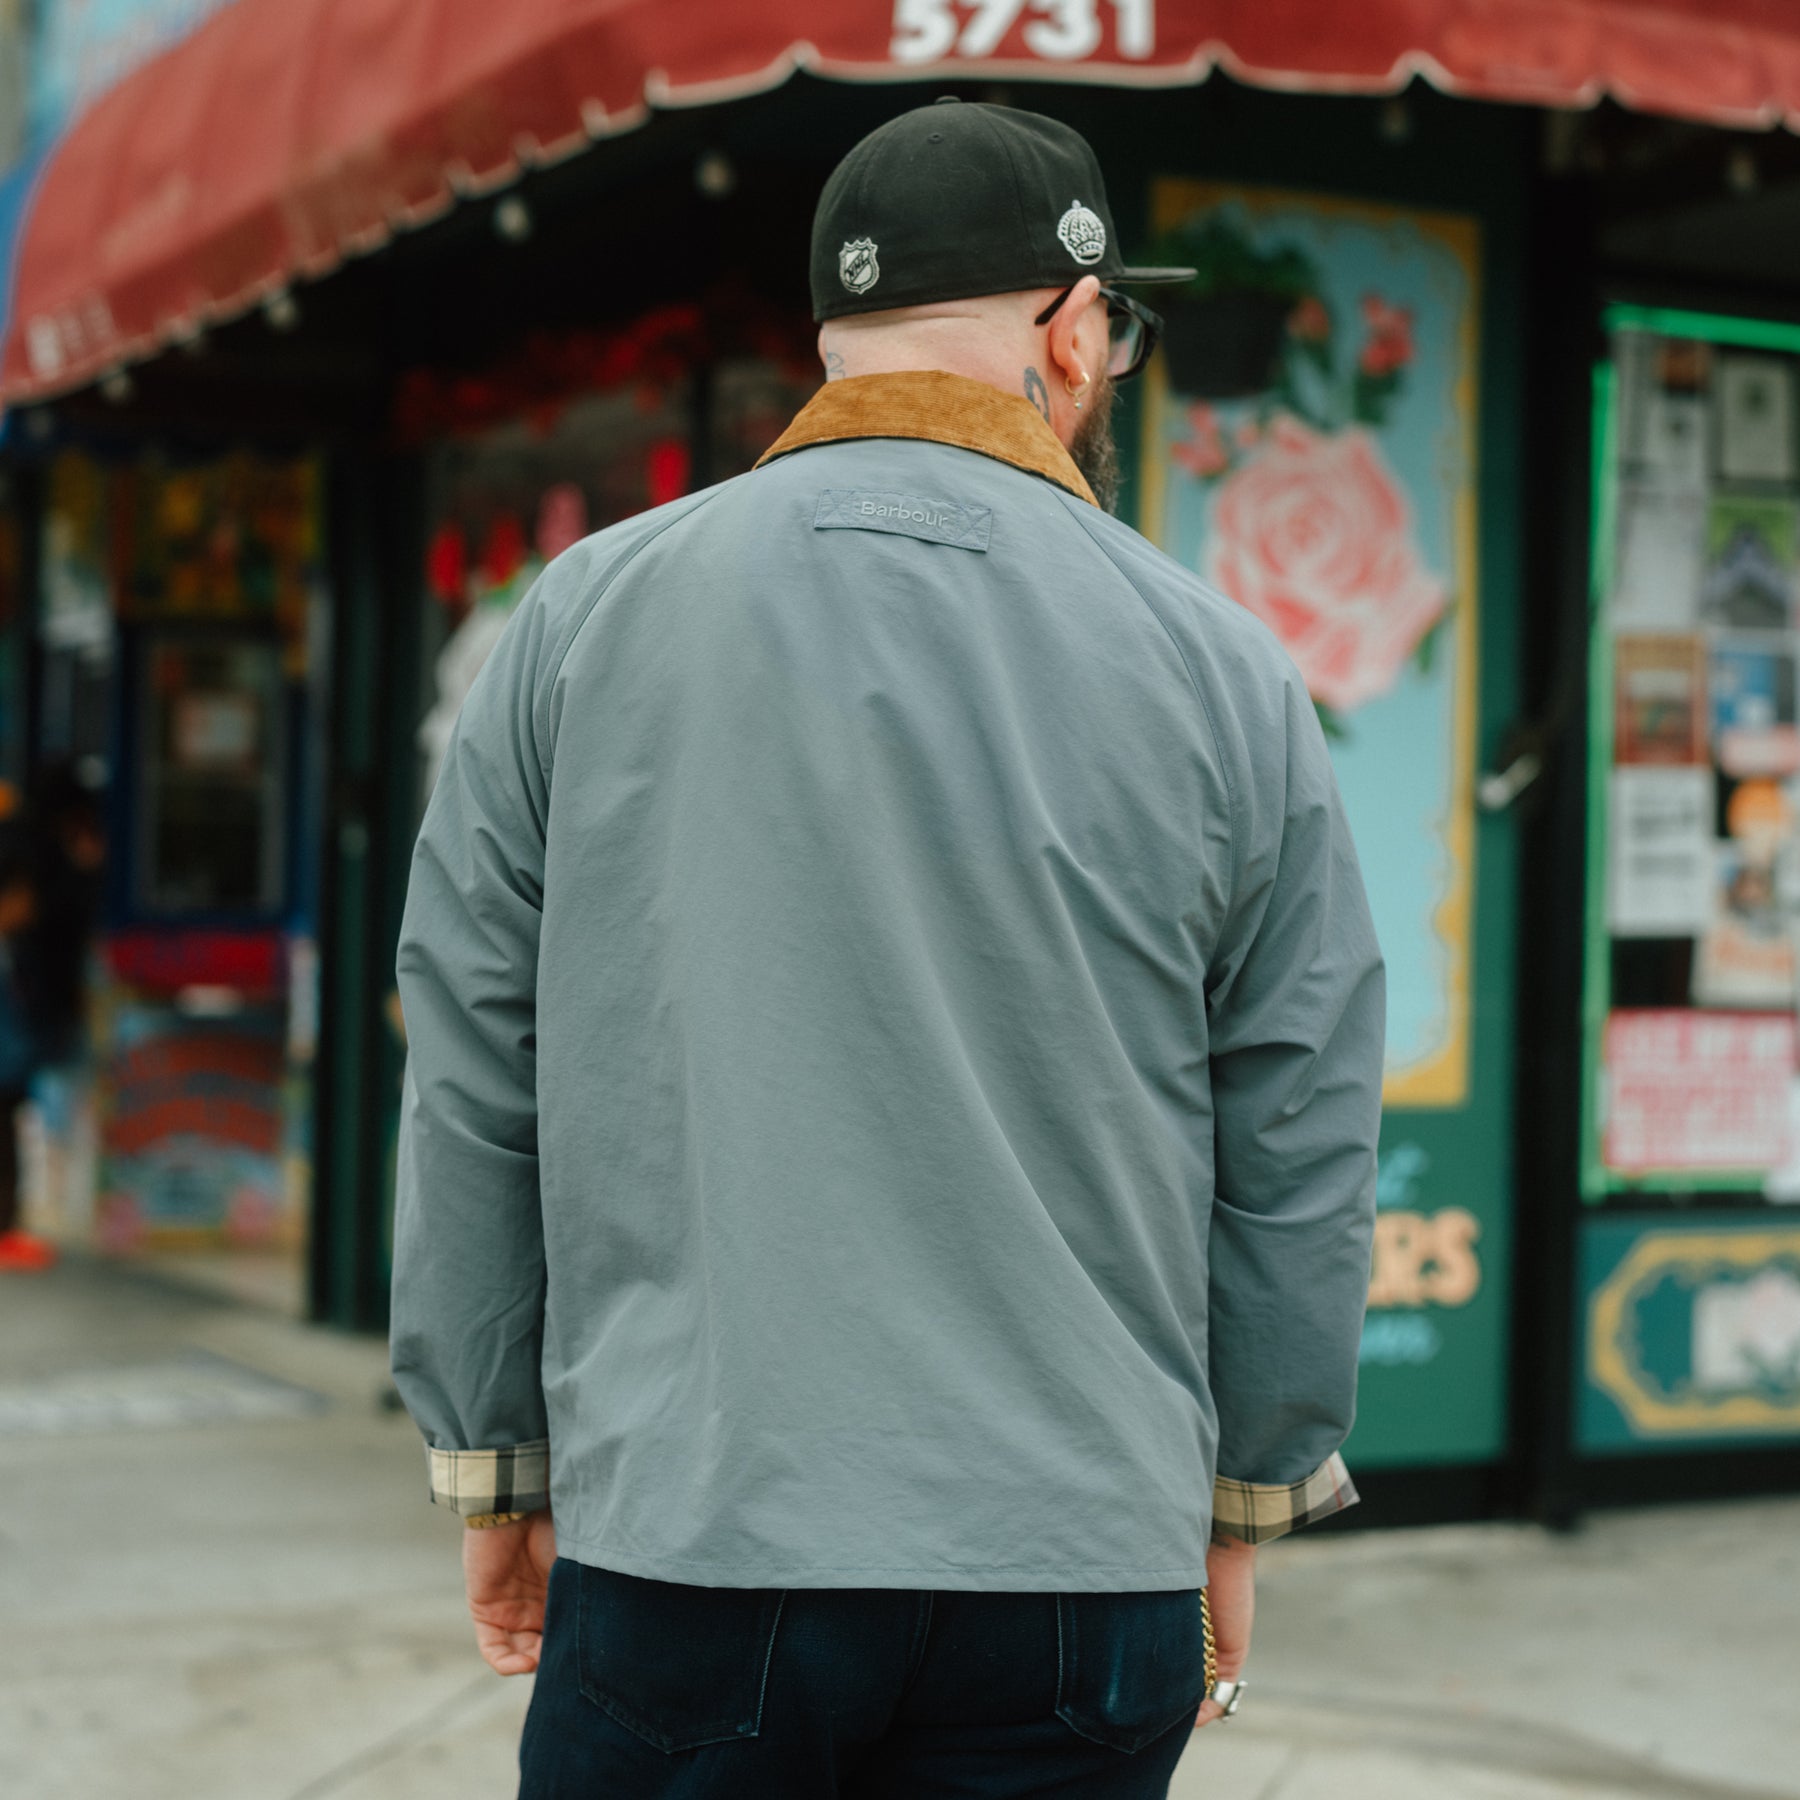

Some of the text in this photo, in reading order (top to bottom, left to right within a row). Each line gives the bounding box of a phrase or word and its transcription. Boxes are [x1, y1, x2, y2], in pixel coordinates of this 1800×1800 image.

[888, 0, 1156, 64] 5731
[861, 501, 949, 527] Barbour
[1367, 1207, 1482, 1308] RS
